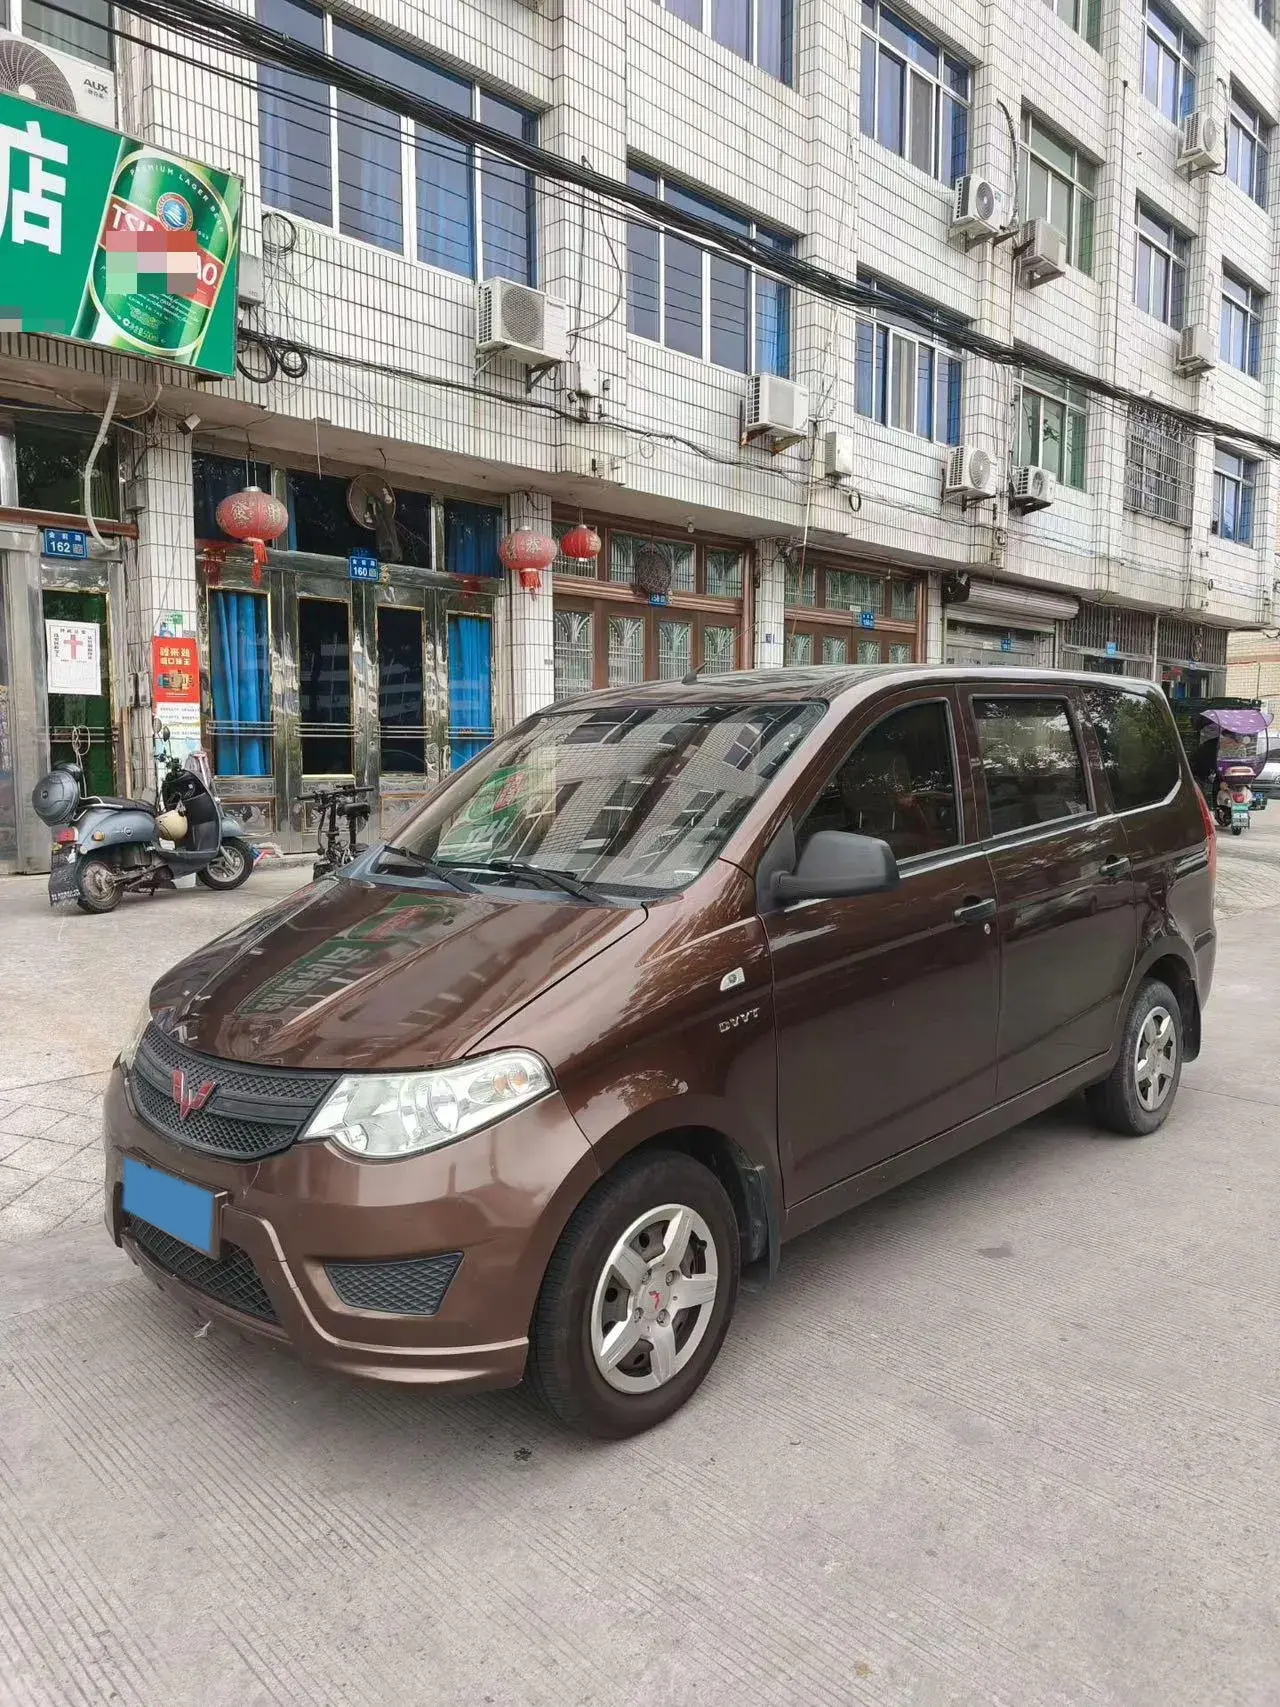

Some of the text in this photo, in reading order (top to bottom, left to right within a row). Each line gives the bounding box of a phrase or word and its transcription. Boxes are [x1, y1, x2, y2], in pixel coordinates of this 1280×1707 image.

[83, 79, 108, 93] AUX
[0, 120, 68, 254] 店
[178, 173, 209, 202] LAGER
[210, 205, 224, 233] BEER
[50, 541, 71, 553] 162
[353, 566, 369, 577] 160
